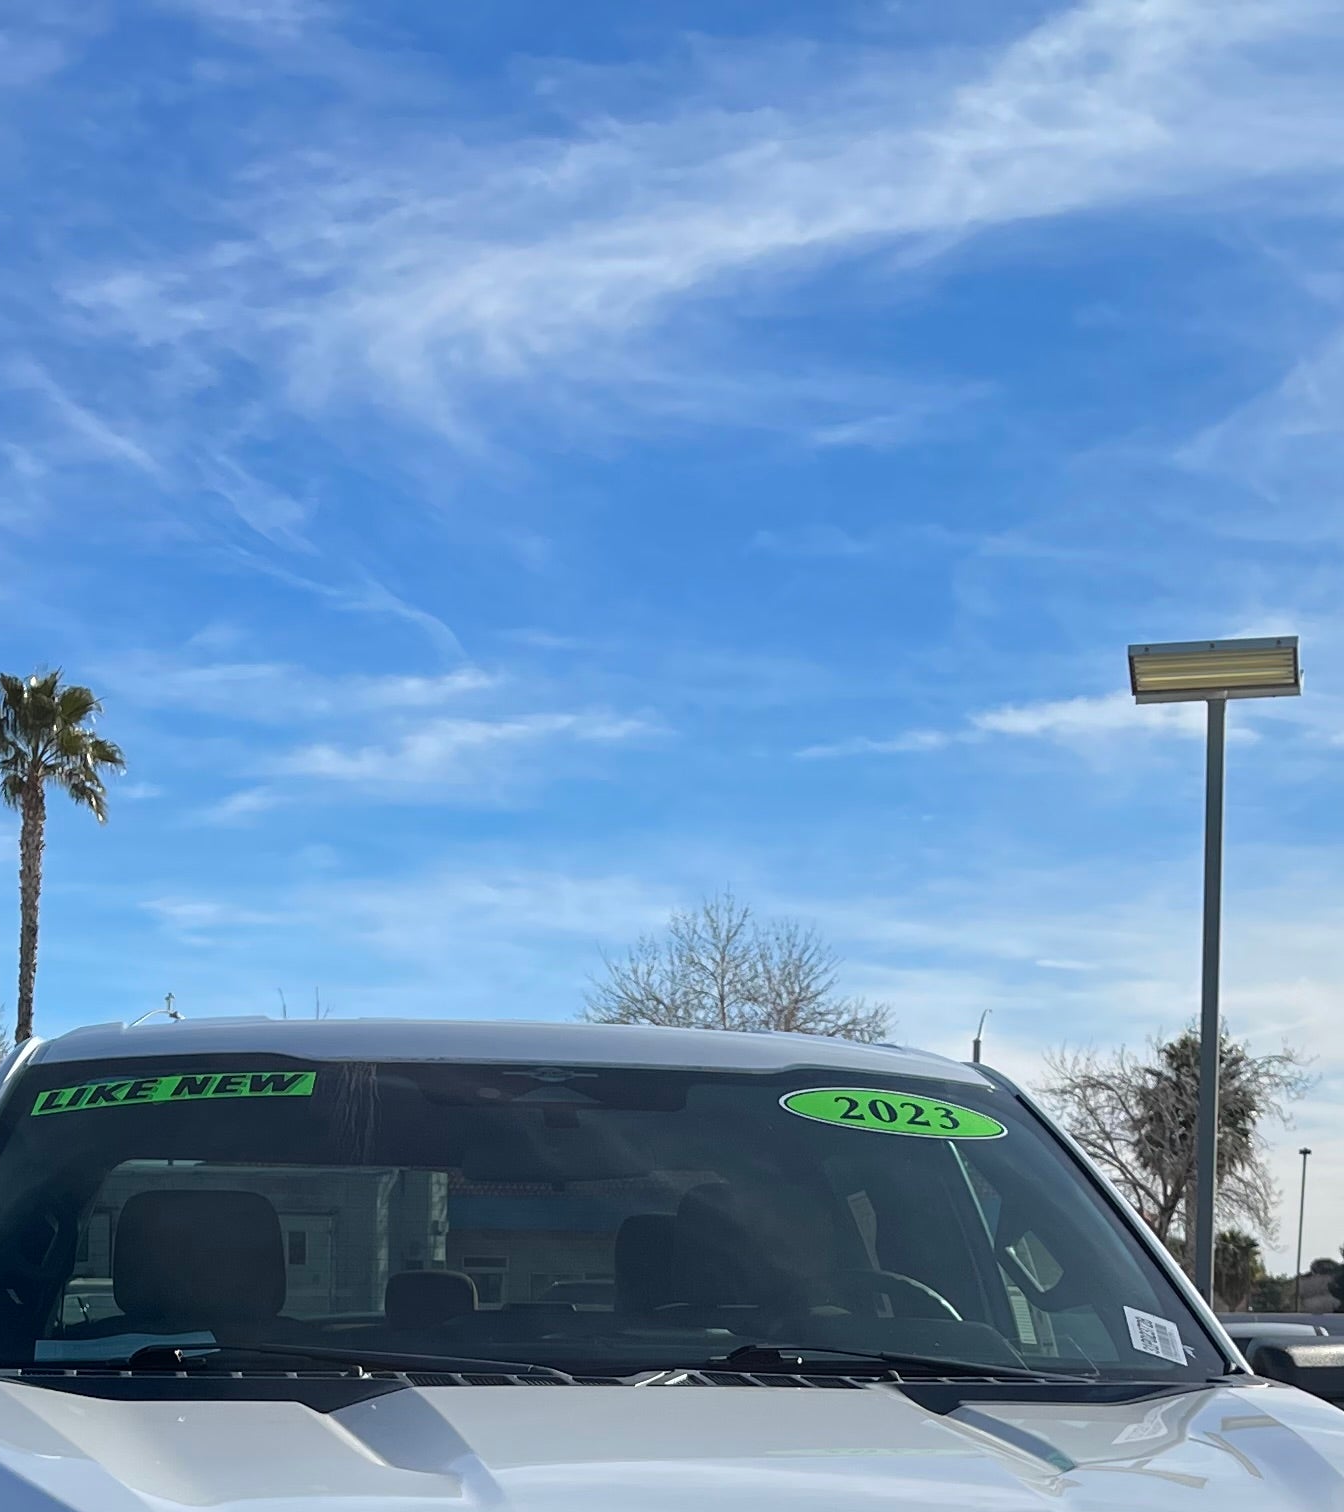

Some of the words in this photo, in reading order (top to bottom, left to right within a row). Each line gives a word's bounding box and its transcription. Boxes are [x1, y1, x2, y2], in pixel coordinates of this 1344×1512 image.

[38, 1078, 158, 1111] LIKE
[170, 1073, 304, 1097] NEW
[834, 1096, 960, 1130] 2023
